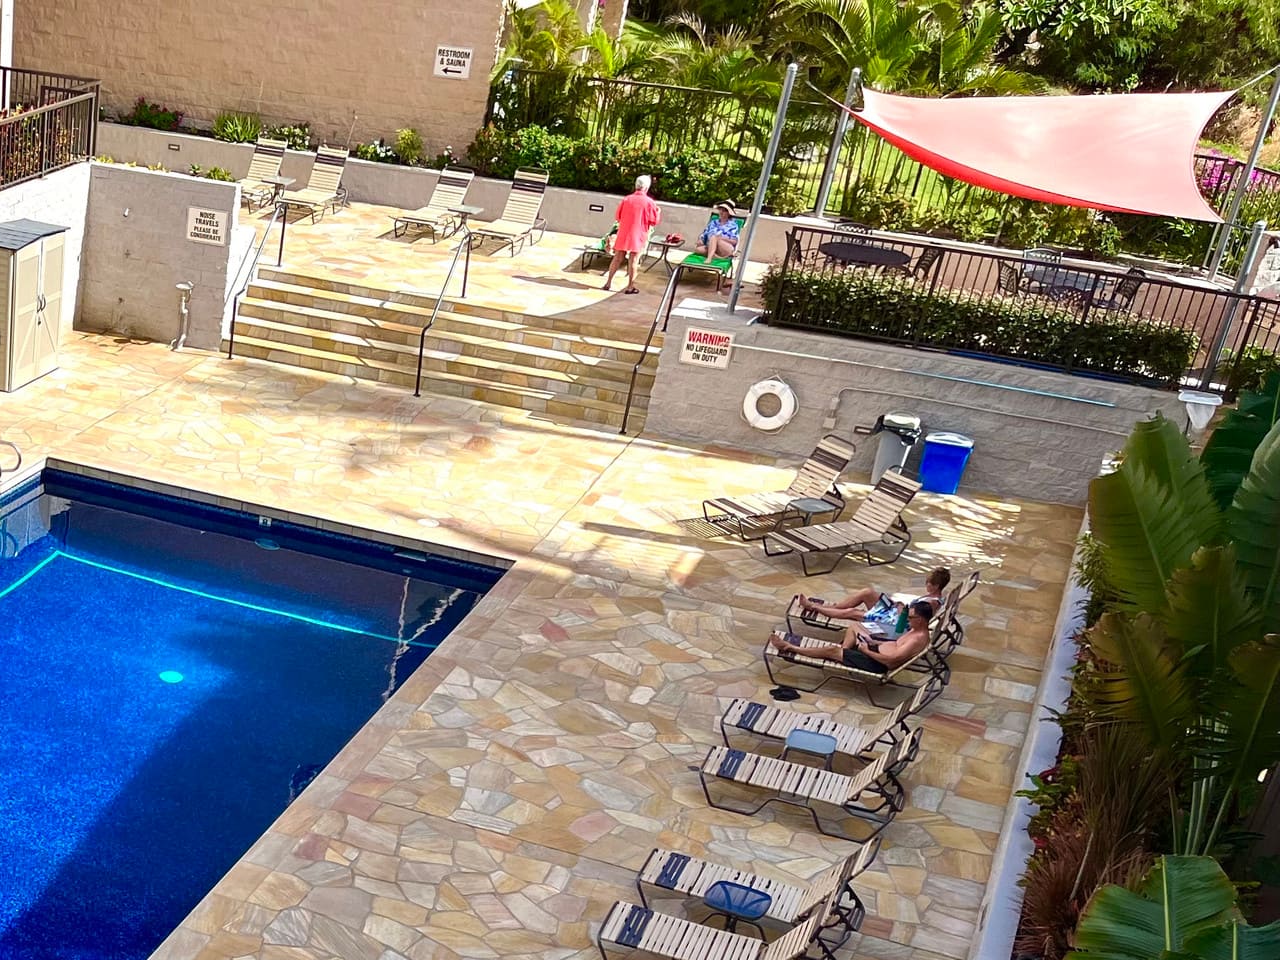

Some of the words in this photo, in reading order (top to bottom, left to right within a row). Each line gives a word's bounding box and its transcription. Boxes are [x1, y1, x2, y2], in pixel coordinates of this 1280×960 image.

[438, 48, 470, 59] RESTROOM
[446, 58, 466, 67] SAUNA
[199, 211, 216, 220] NOISE
[195, 217, 219, 228] TRAVELS
[689, 330, 730, 348] WARNING
[686, 343, 695, 352] NO
[695, 345, 728, 357] LIFEGUARD
[692, 352, 701, 361] ON
[701, 354, 718, 363] DUTY
